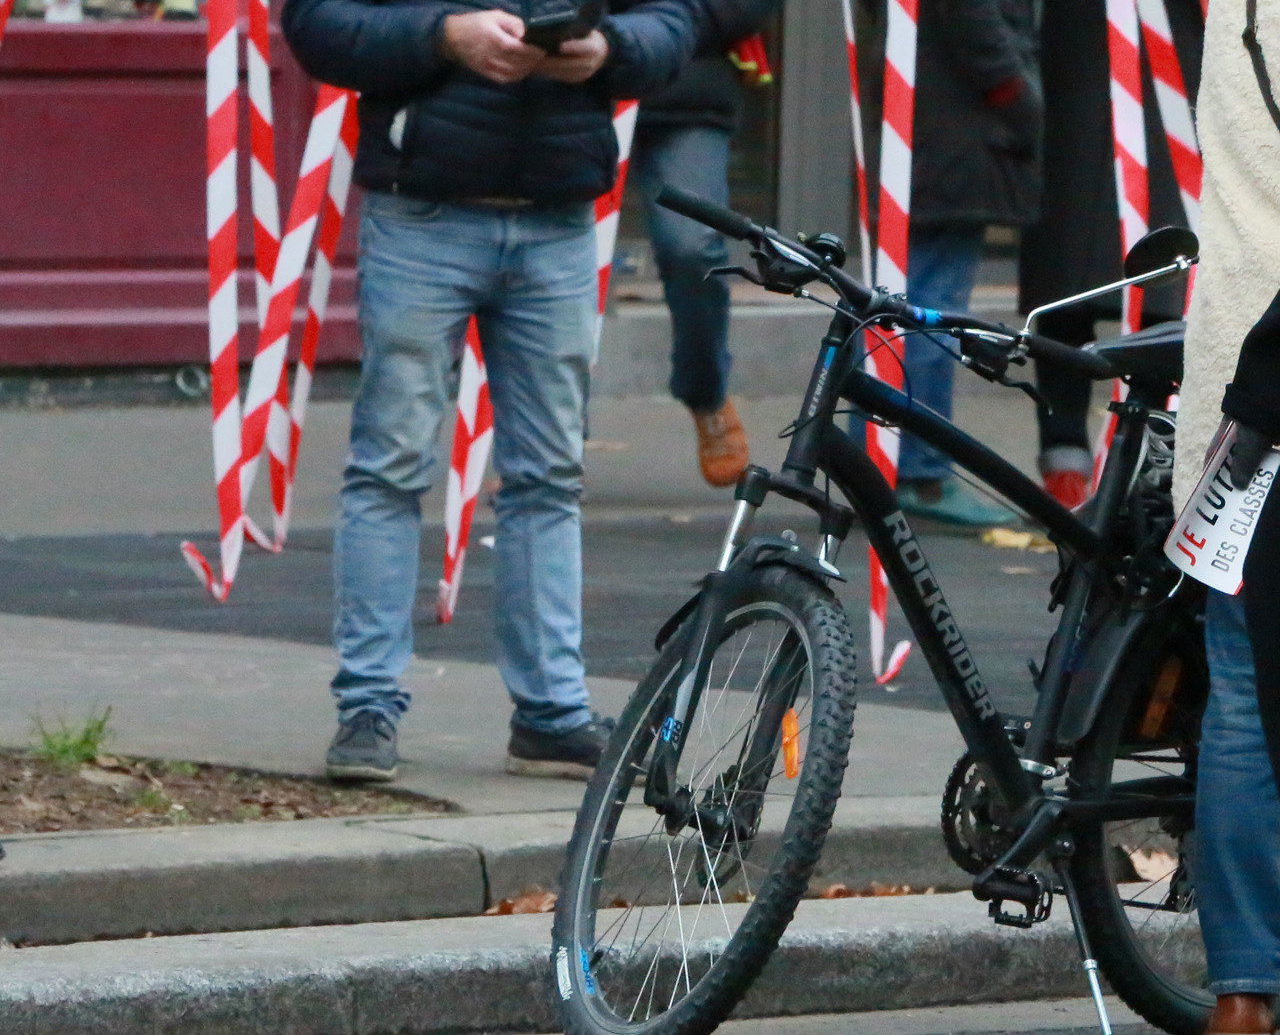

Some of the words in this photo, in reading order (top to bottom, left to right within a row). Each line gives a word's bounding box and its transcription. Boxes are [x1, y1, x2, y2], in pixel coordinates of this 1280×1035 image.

[1175, 525, 1207, 567] JE
[1210, 541, 1239, 573] DES
[1229, 468, 1274, 537] CLASSES
